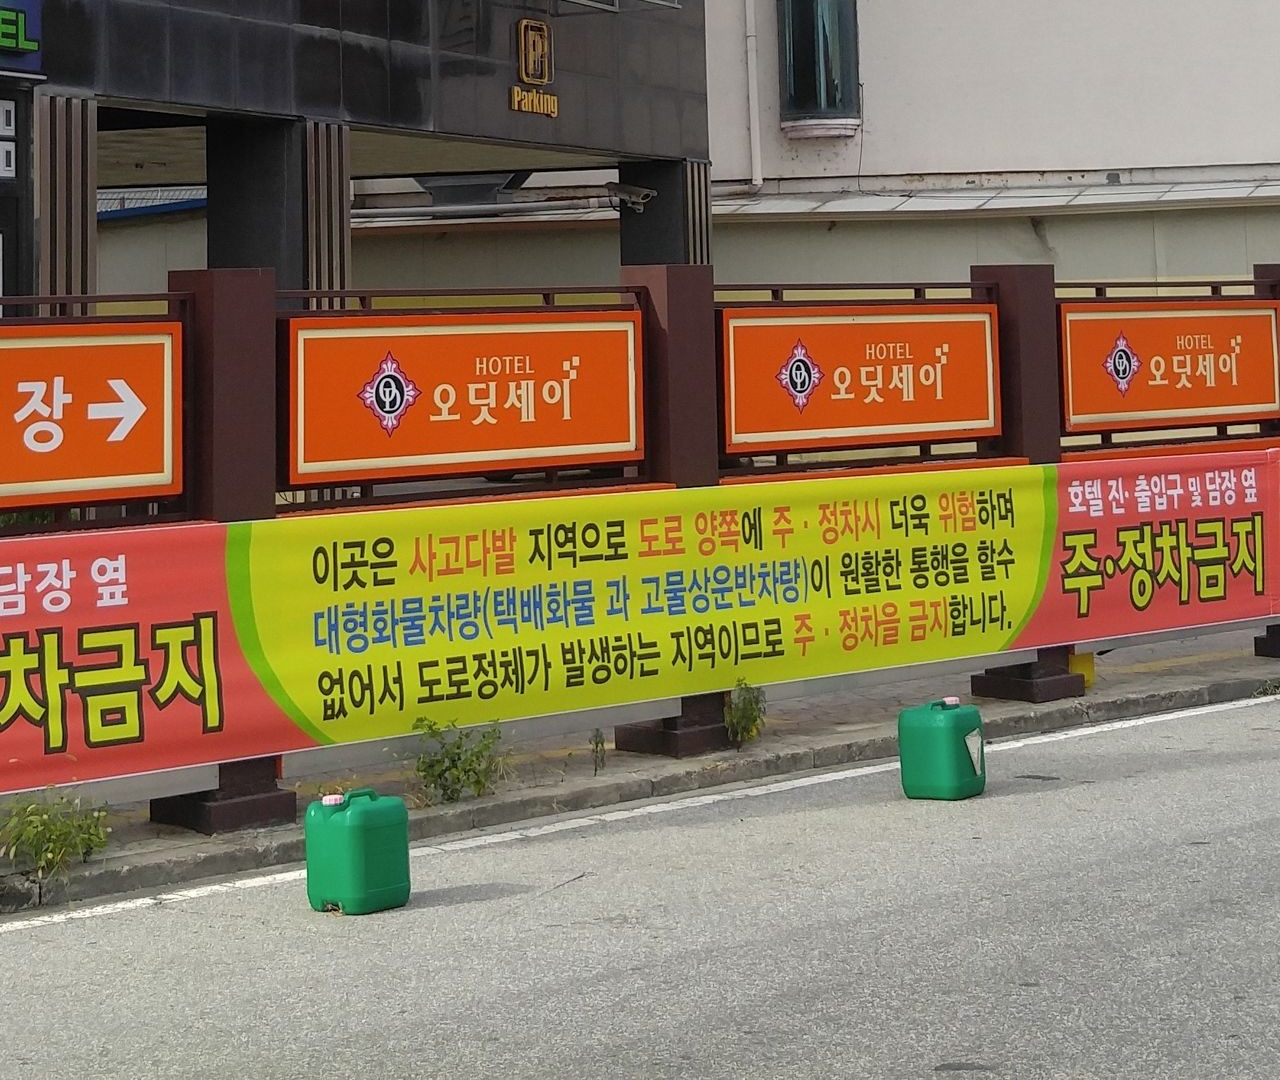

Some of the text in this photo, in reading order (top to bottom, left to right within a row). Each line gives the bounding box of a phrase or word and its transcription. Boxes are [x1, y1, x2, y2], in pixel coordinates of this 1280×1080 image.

[511, 85, 559, 119] Parking
[865, 343, 914, 360] HOTEL
[1176, 334, 1214, 351] HOTEL
[475, 355, 535, 376] HOTEL
[830, 363, 944, 404] 오딧세이
[1148, 352, 1239, 390] 오딧세이
[429, 378, 573, 425] 오딧세이
[1067, 478, 1104, 517] 호텔
[1188, 476, 1202, 507] 및
[1205, 469, 1237, 506] 담장
[1241, 468, 1258, 503] 옆
[312, 536, 398, 592] 이곳은
[408, 526, 517, 582] 사고다발
[528, 519, 628, 570] 지역으로
[637, 514, 686, 559] 도로
[694, 506, 763, 558] 양쪽에
[890, 494, 930, 538] 더욱
[937, 487, 1016, 535] 위험하며
[91, 553, 130, 607] 옆
[606, 575, 631, 621] 과
[839, 548, 903, 596] 원활한
[909, 541, 970, 590] 통행을
[977, 538, 1017, 581] 할수
[317, 660, 407, 722] 없어서
[416, 642, 552, 704] 도로정체가
[560, 630, 661, 688] 발생하는
[670, 617, 785, 673] 지역이므로
[908, 589, 1012, 643] 금지합니다.
